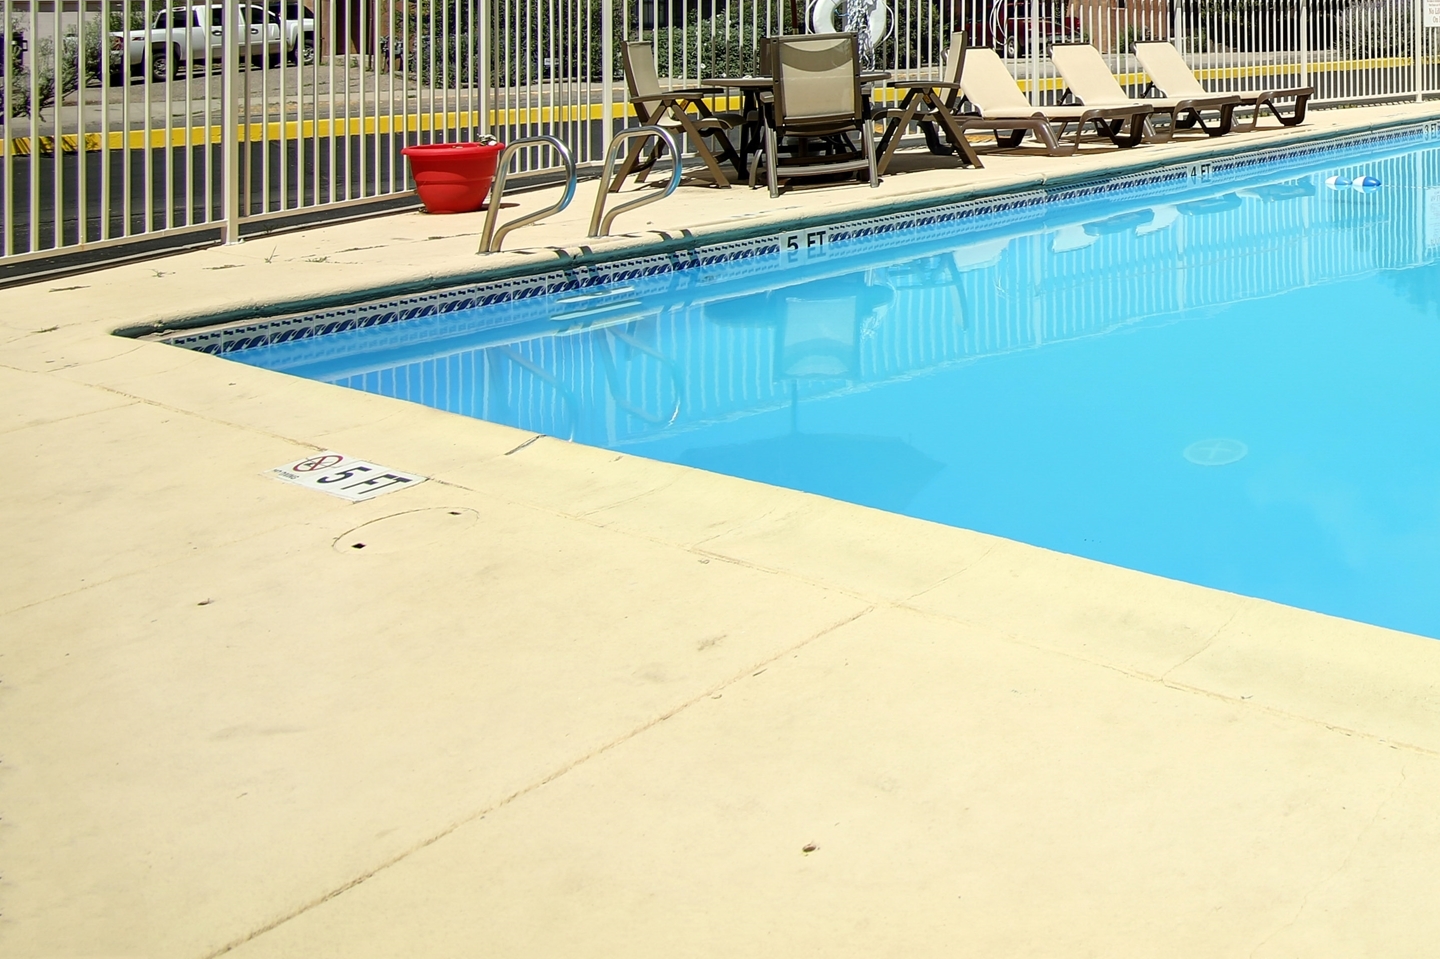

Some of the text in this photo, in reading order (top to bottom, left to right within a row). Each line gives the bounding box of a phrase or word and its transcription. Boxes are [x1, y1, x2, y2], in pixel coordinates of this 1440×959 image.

[1191, 163, 1211, 176] 4 FT
[787, 230, 826, 251] 5 FT
[317, 466, 413, 495] 5 FT
